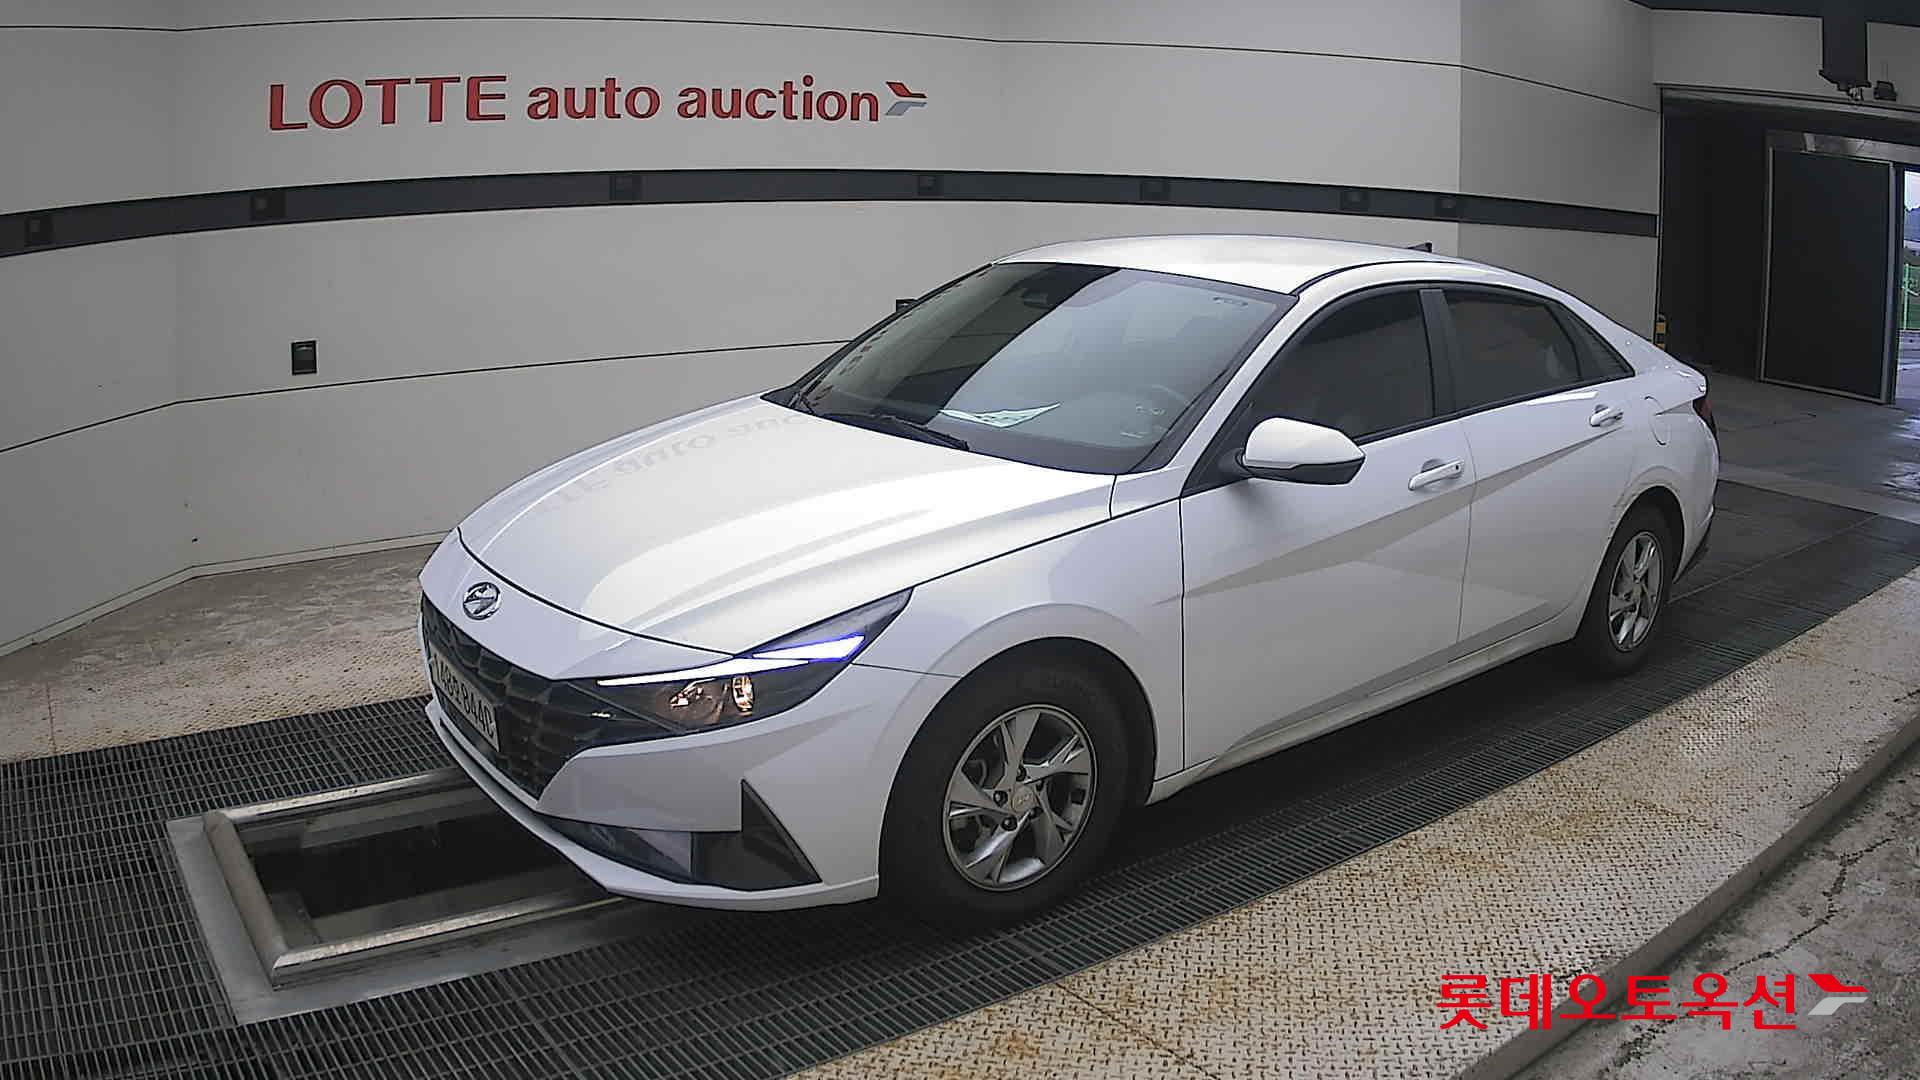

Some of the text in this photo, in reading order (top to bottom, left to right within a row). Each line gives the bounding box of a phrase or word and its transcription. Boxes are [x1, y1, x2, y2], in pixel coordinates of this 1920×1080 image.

[268, 74, 881, 131] LOTTE auto auction
